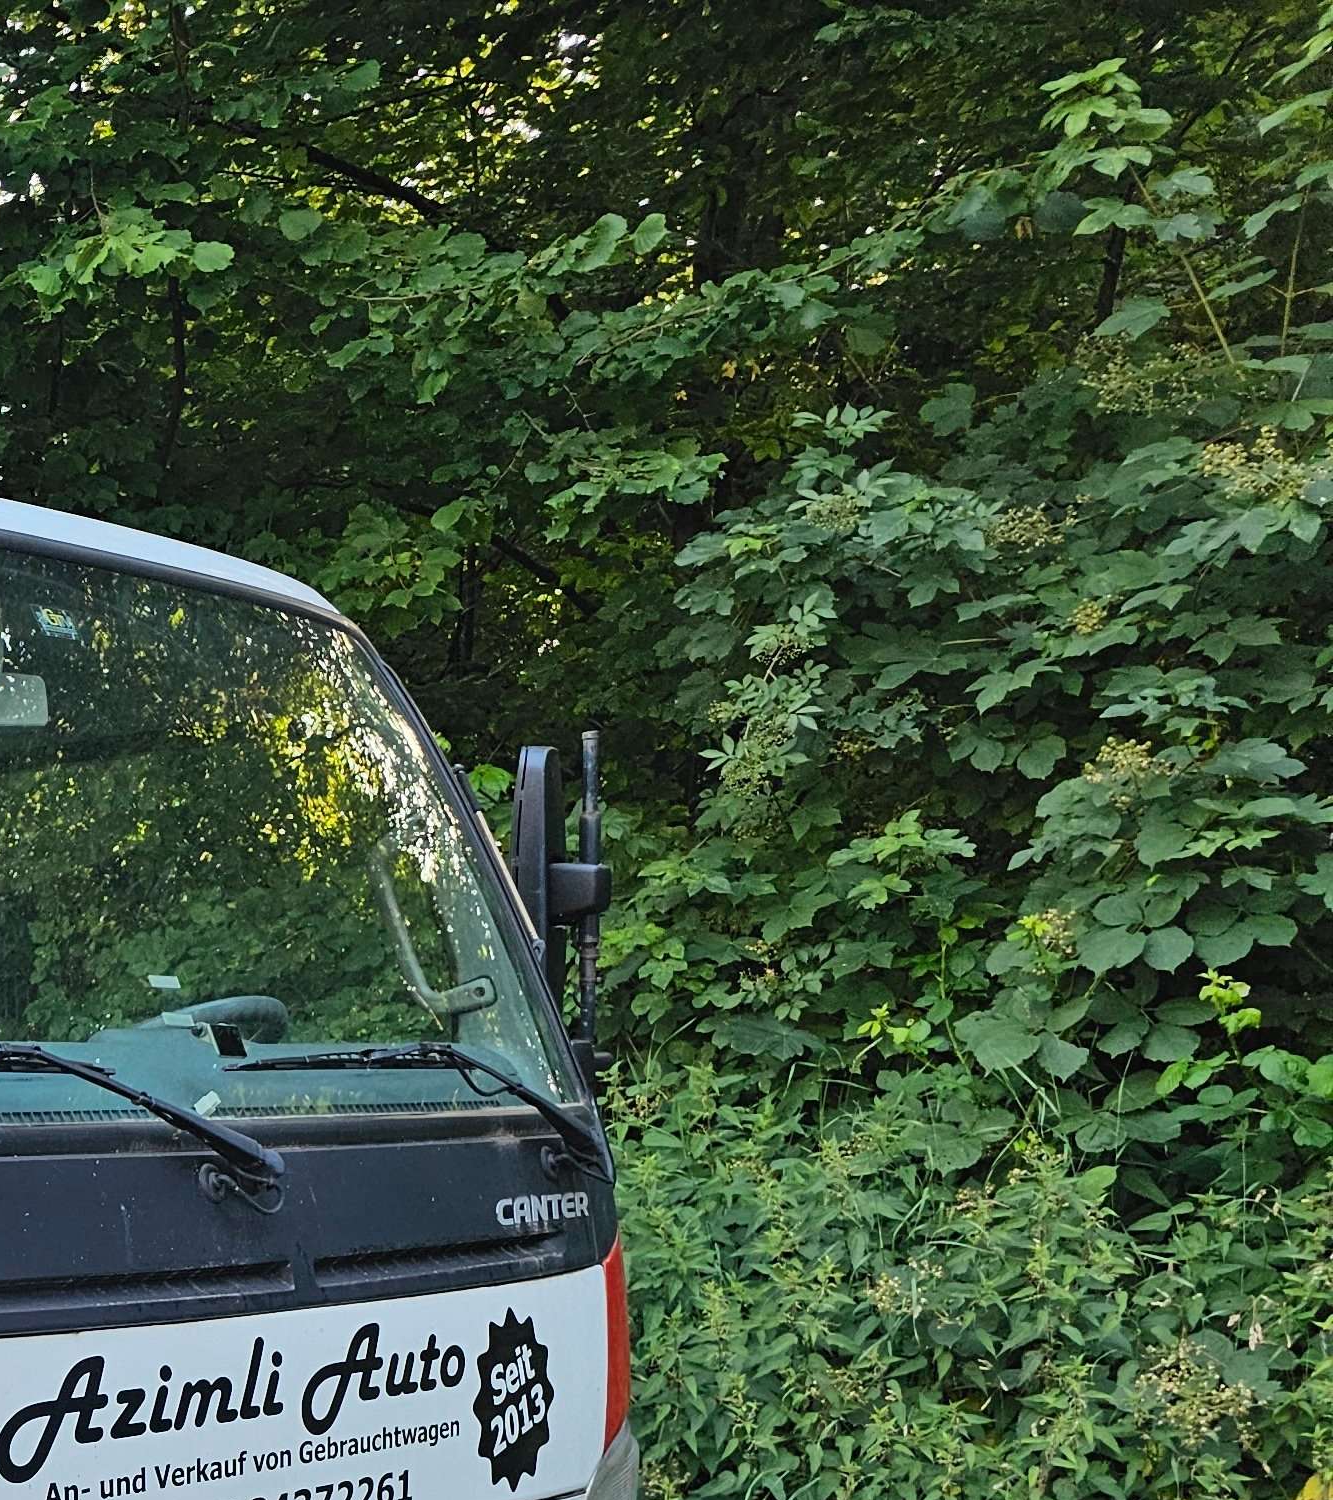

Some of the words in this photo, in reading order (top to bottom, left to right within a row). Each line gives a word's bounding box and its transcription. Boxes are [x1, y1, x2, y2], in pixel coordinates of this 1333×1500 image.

[494, 1191, 589, 1227] CANTER
[301, 1322, 466, 1436] Auto
[489, 1343, 536, 1399] Seit
[99, 1466, 146, 1497] und
[155, 1450, 248, 1489] Verkauf
[253, 1446, 292, 1470] von
[298, 1416, 461, 1467] Gebrauchtwagen
[489, 1393, 547, 1458] 2013
